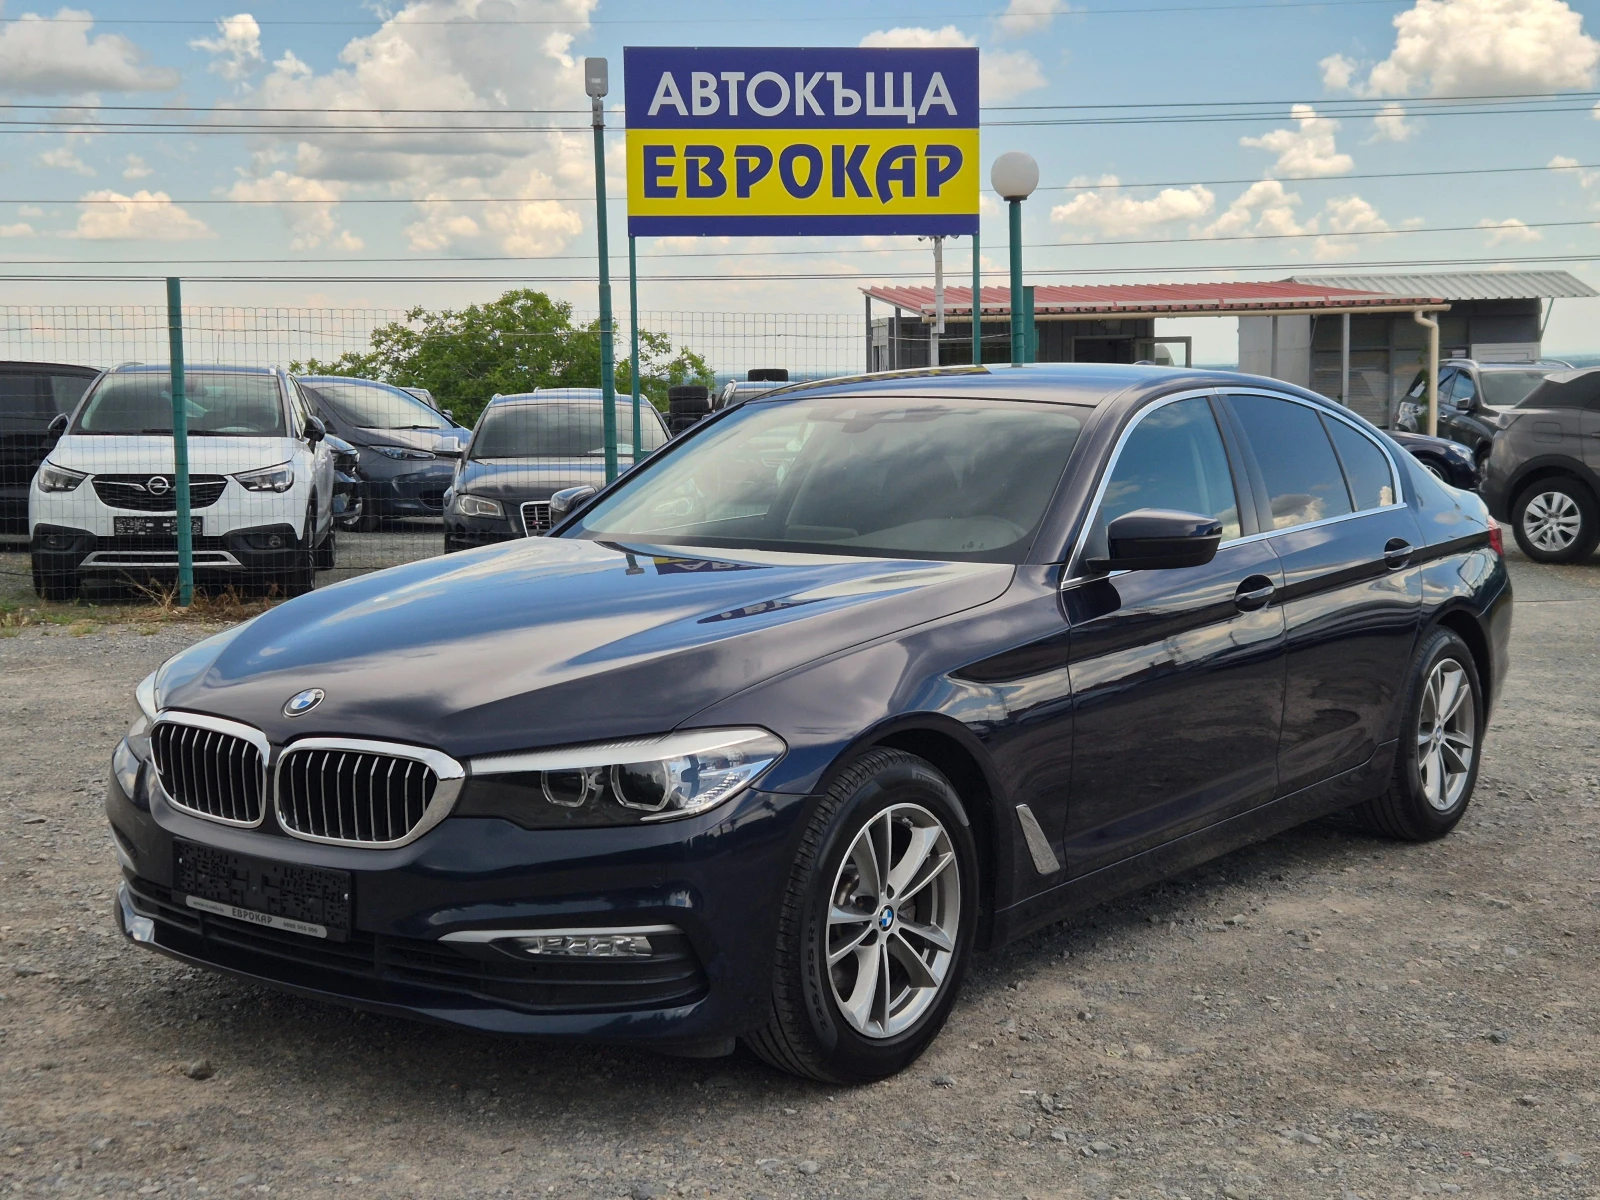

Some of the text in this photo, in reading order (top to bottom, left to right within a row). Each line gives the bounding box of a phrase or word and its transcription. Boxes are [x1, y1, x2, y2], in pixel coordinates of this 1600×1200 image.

[647, 71, 958, 124] АВТОКЪЩА
[643, 143, 963, 205] ЕВРОКАР
[231, 907, 273, 925] ЕВРОКАР
